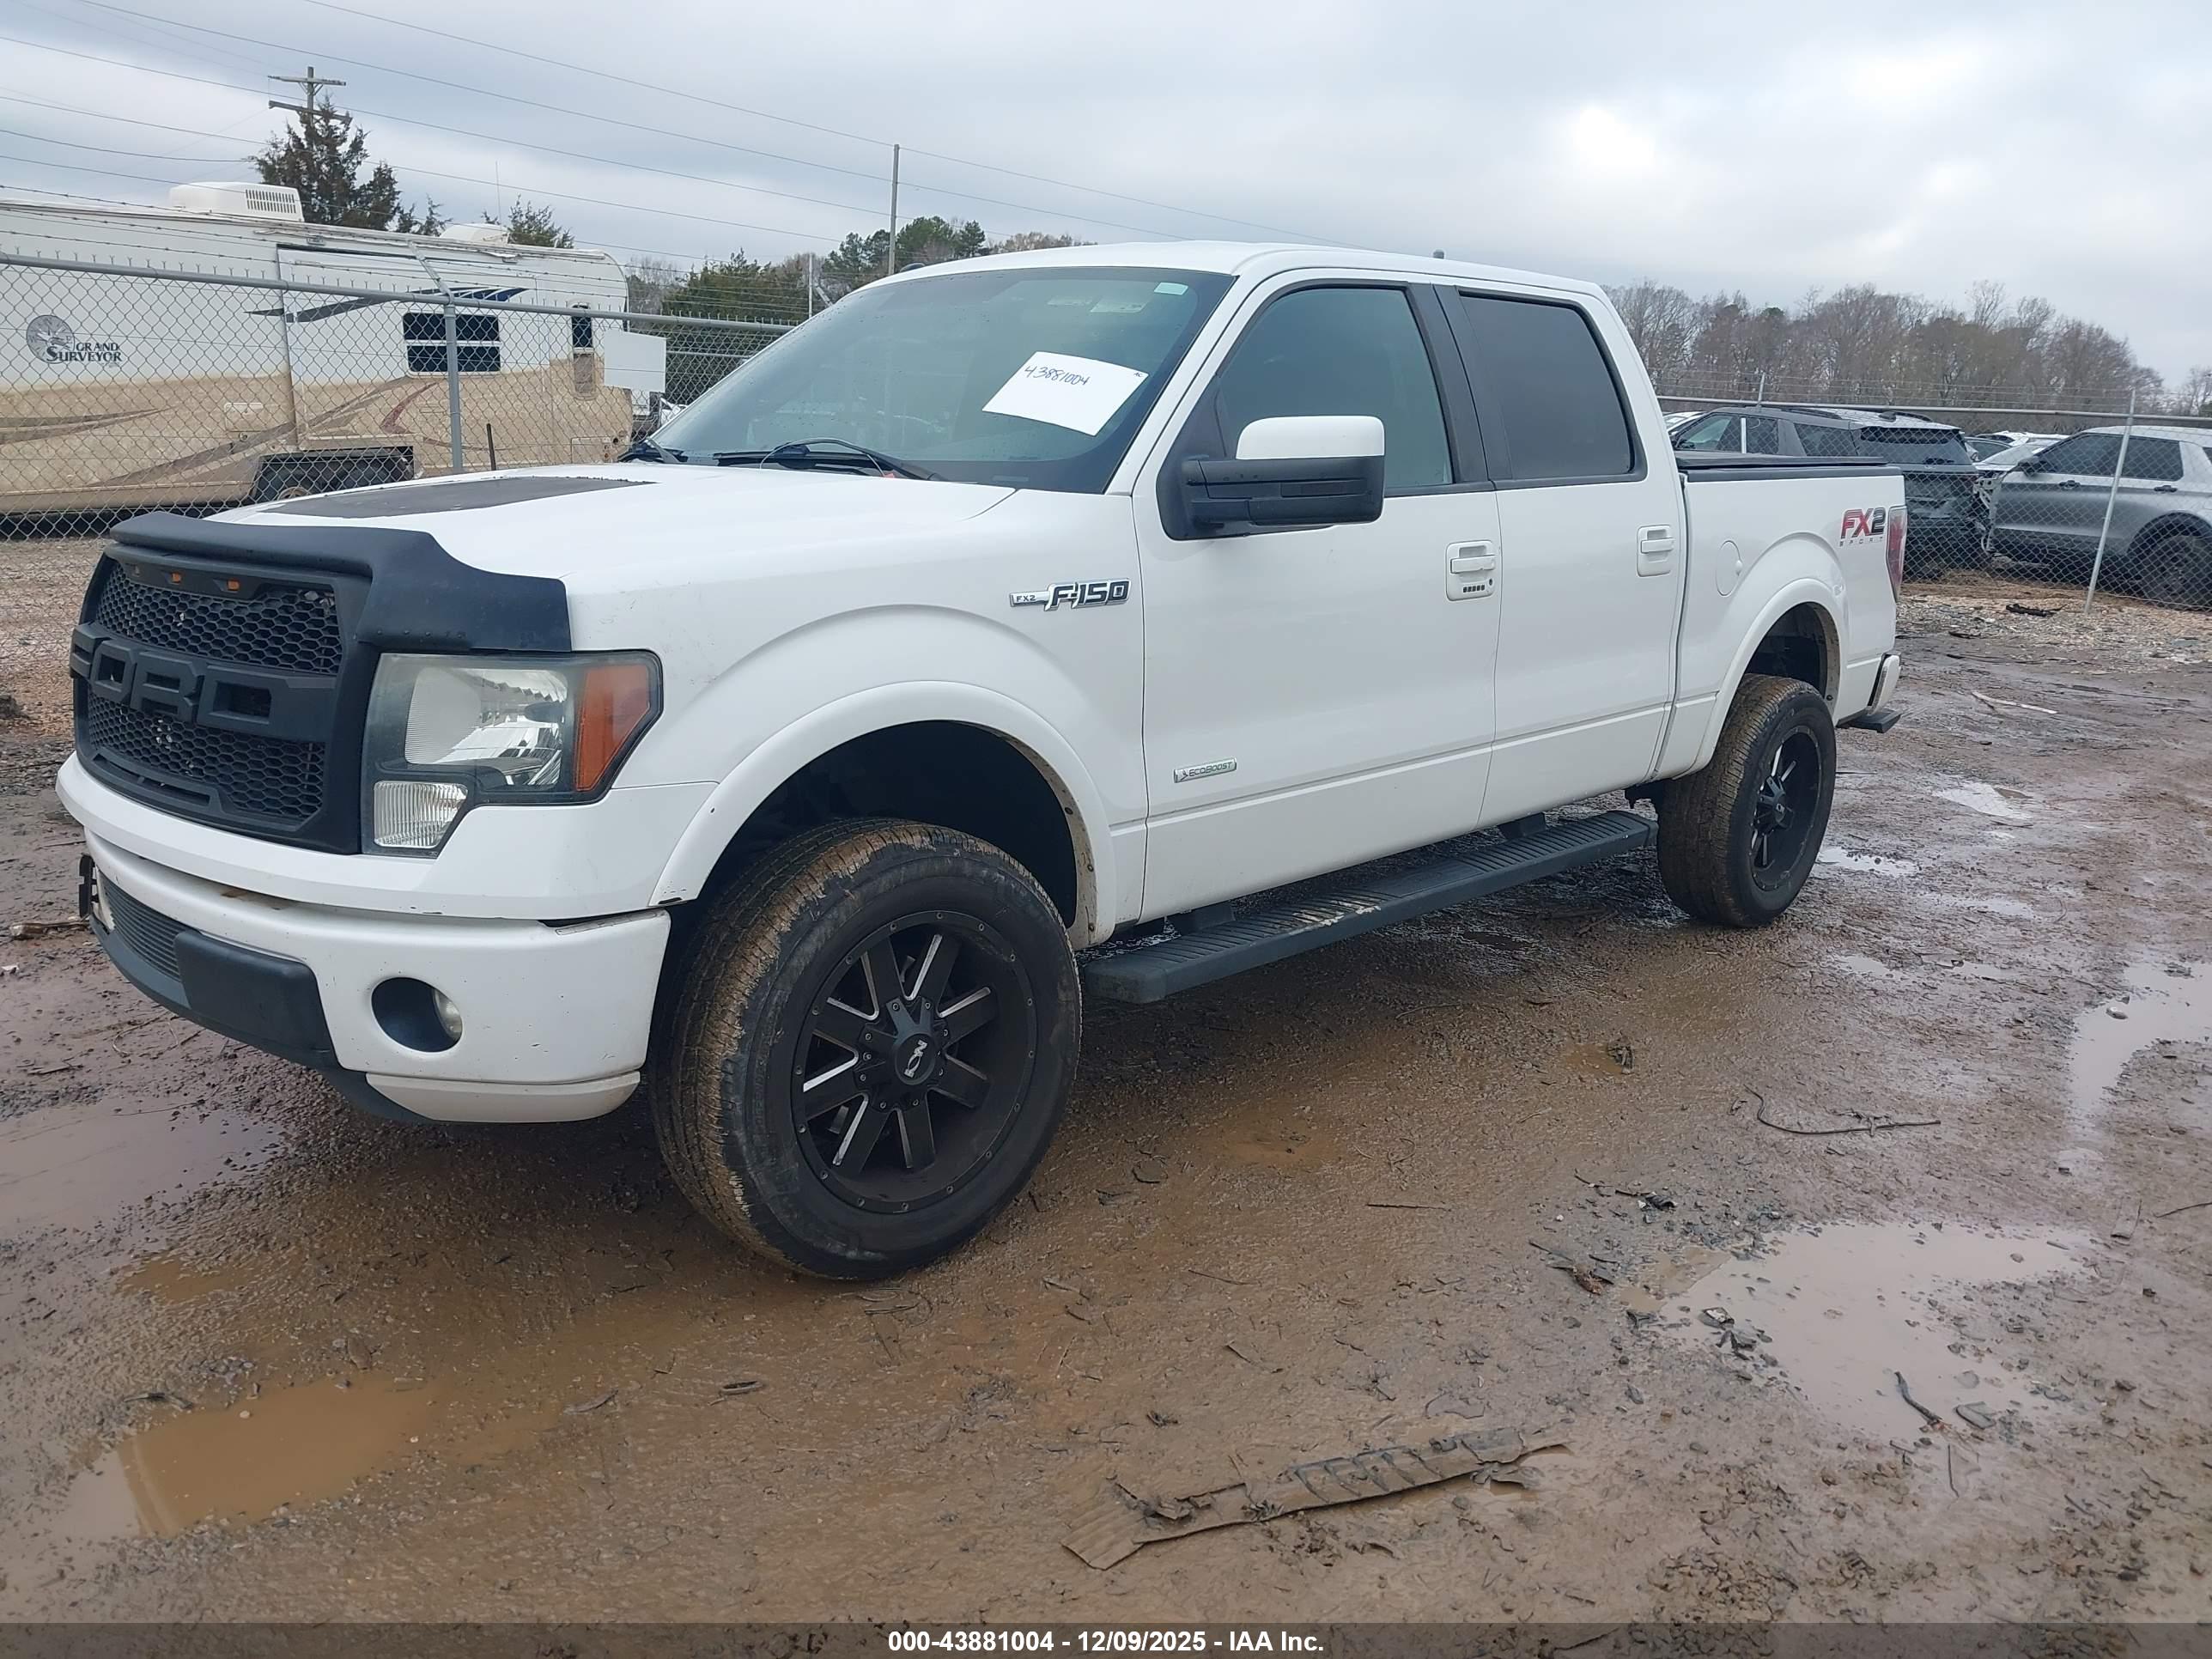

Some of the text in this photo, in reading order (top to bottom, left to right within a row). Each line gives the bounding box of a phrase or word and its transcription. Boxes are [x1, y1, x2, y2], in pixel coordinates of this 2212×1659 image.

[46, 346, 123, 362] SURVEYOR
[76, 343, 119, 352] GRAND
[1024, 365, 1091, 386] 43881004
[1840, 507, 1886, 539] FX2
[1016, 578, 1131, 610] FX2 F-150
